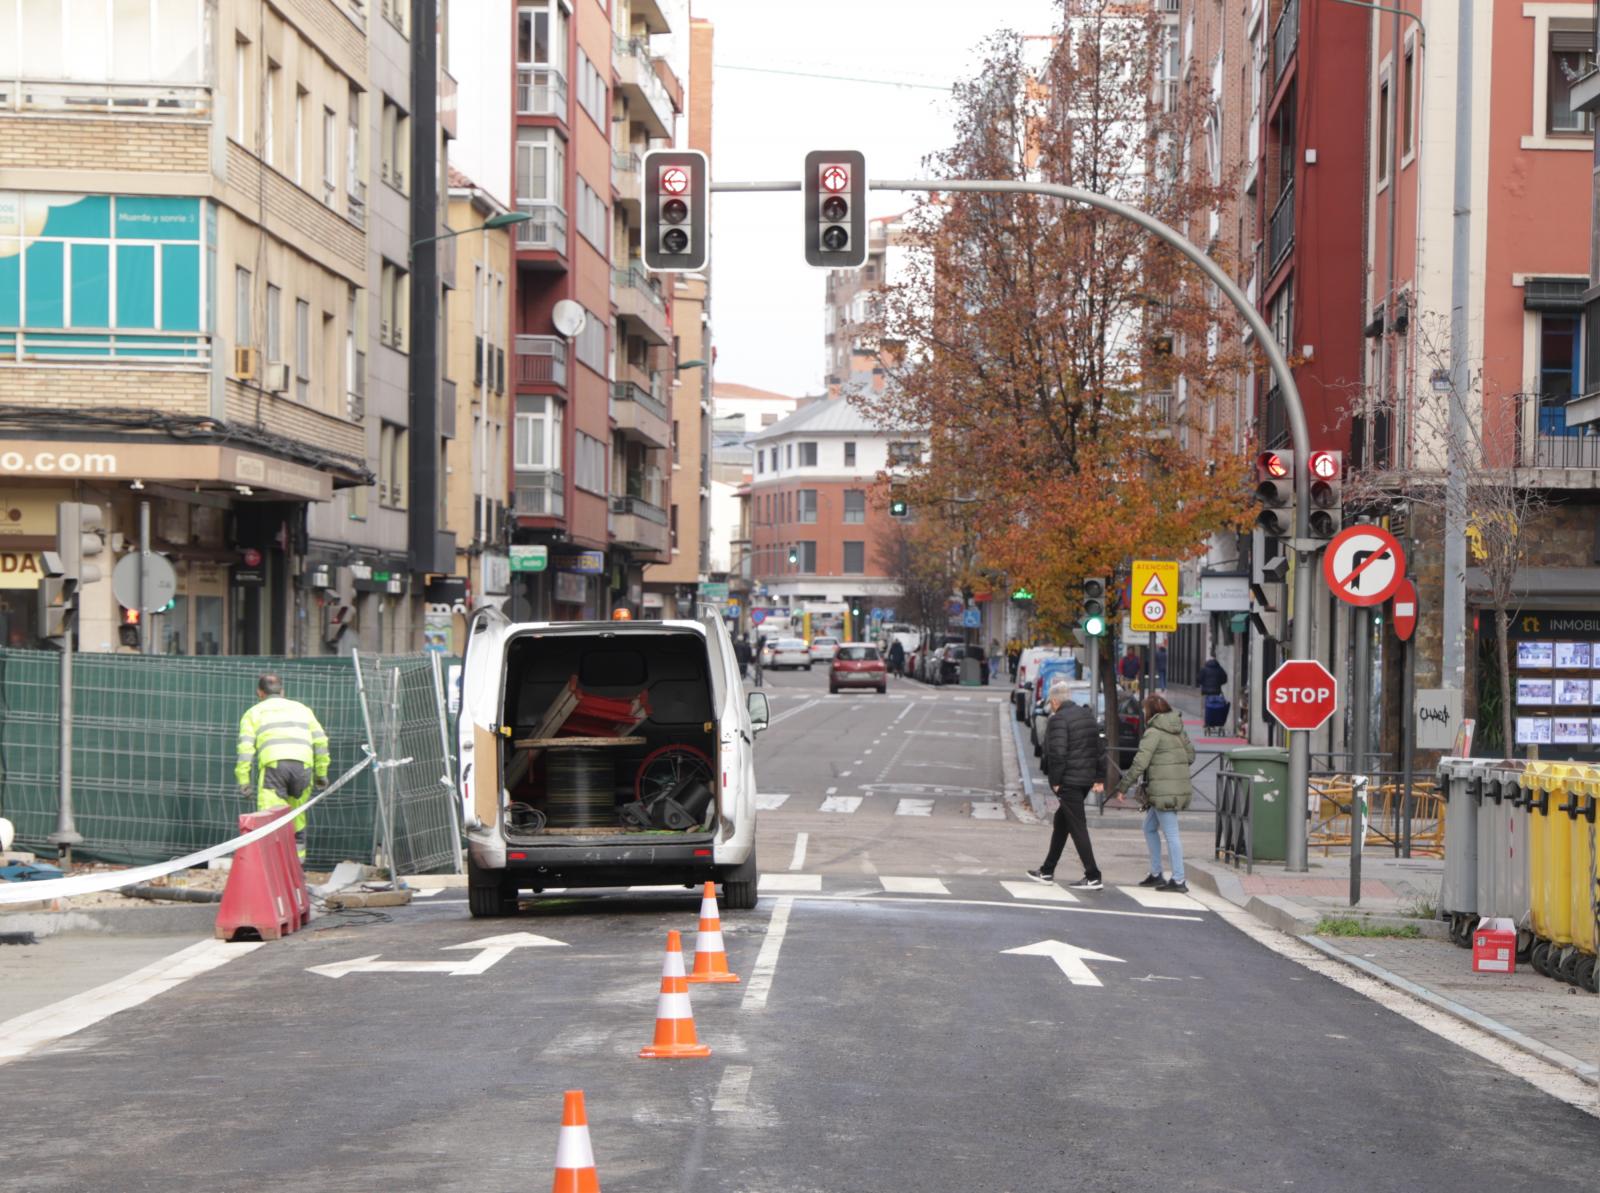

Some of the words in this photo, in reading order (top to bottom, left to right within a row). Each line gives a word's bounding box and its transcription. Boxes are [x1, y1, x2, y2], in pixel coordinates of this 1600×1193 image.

[1, 452, 117, 473] o.com
[1, 552, 38, 573] DA
[1147, 604, 1162, 615] 30
[1274, 688, 1330, 704] STOP
